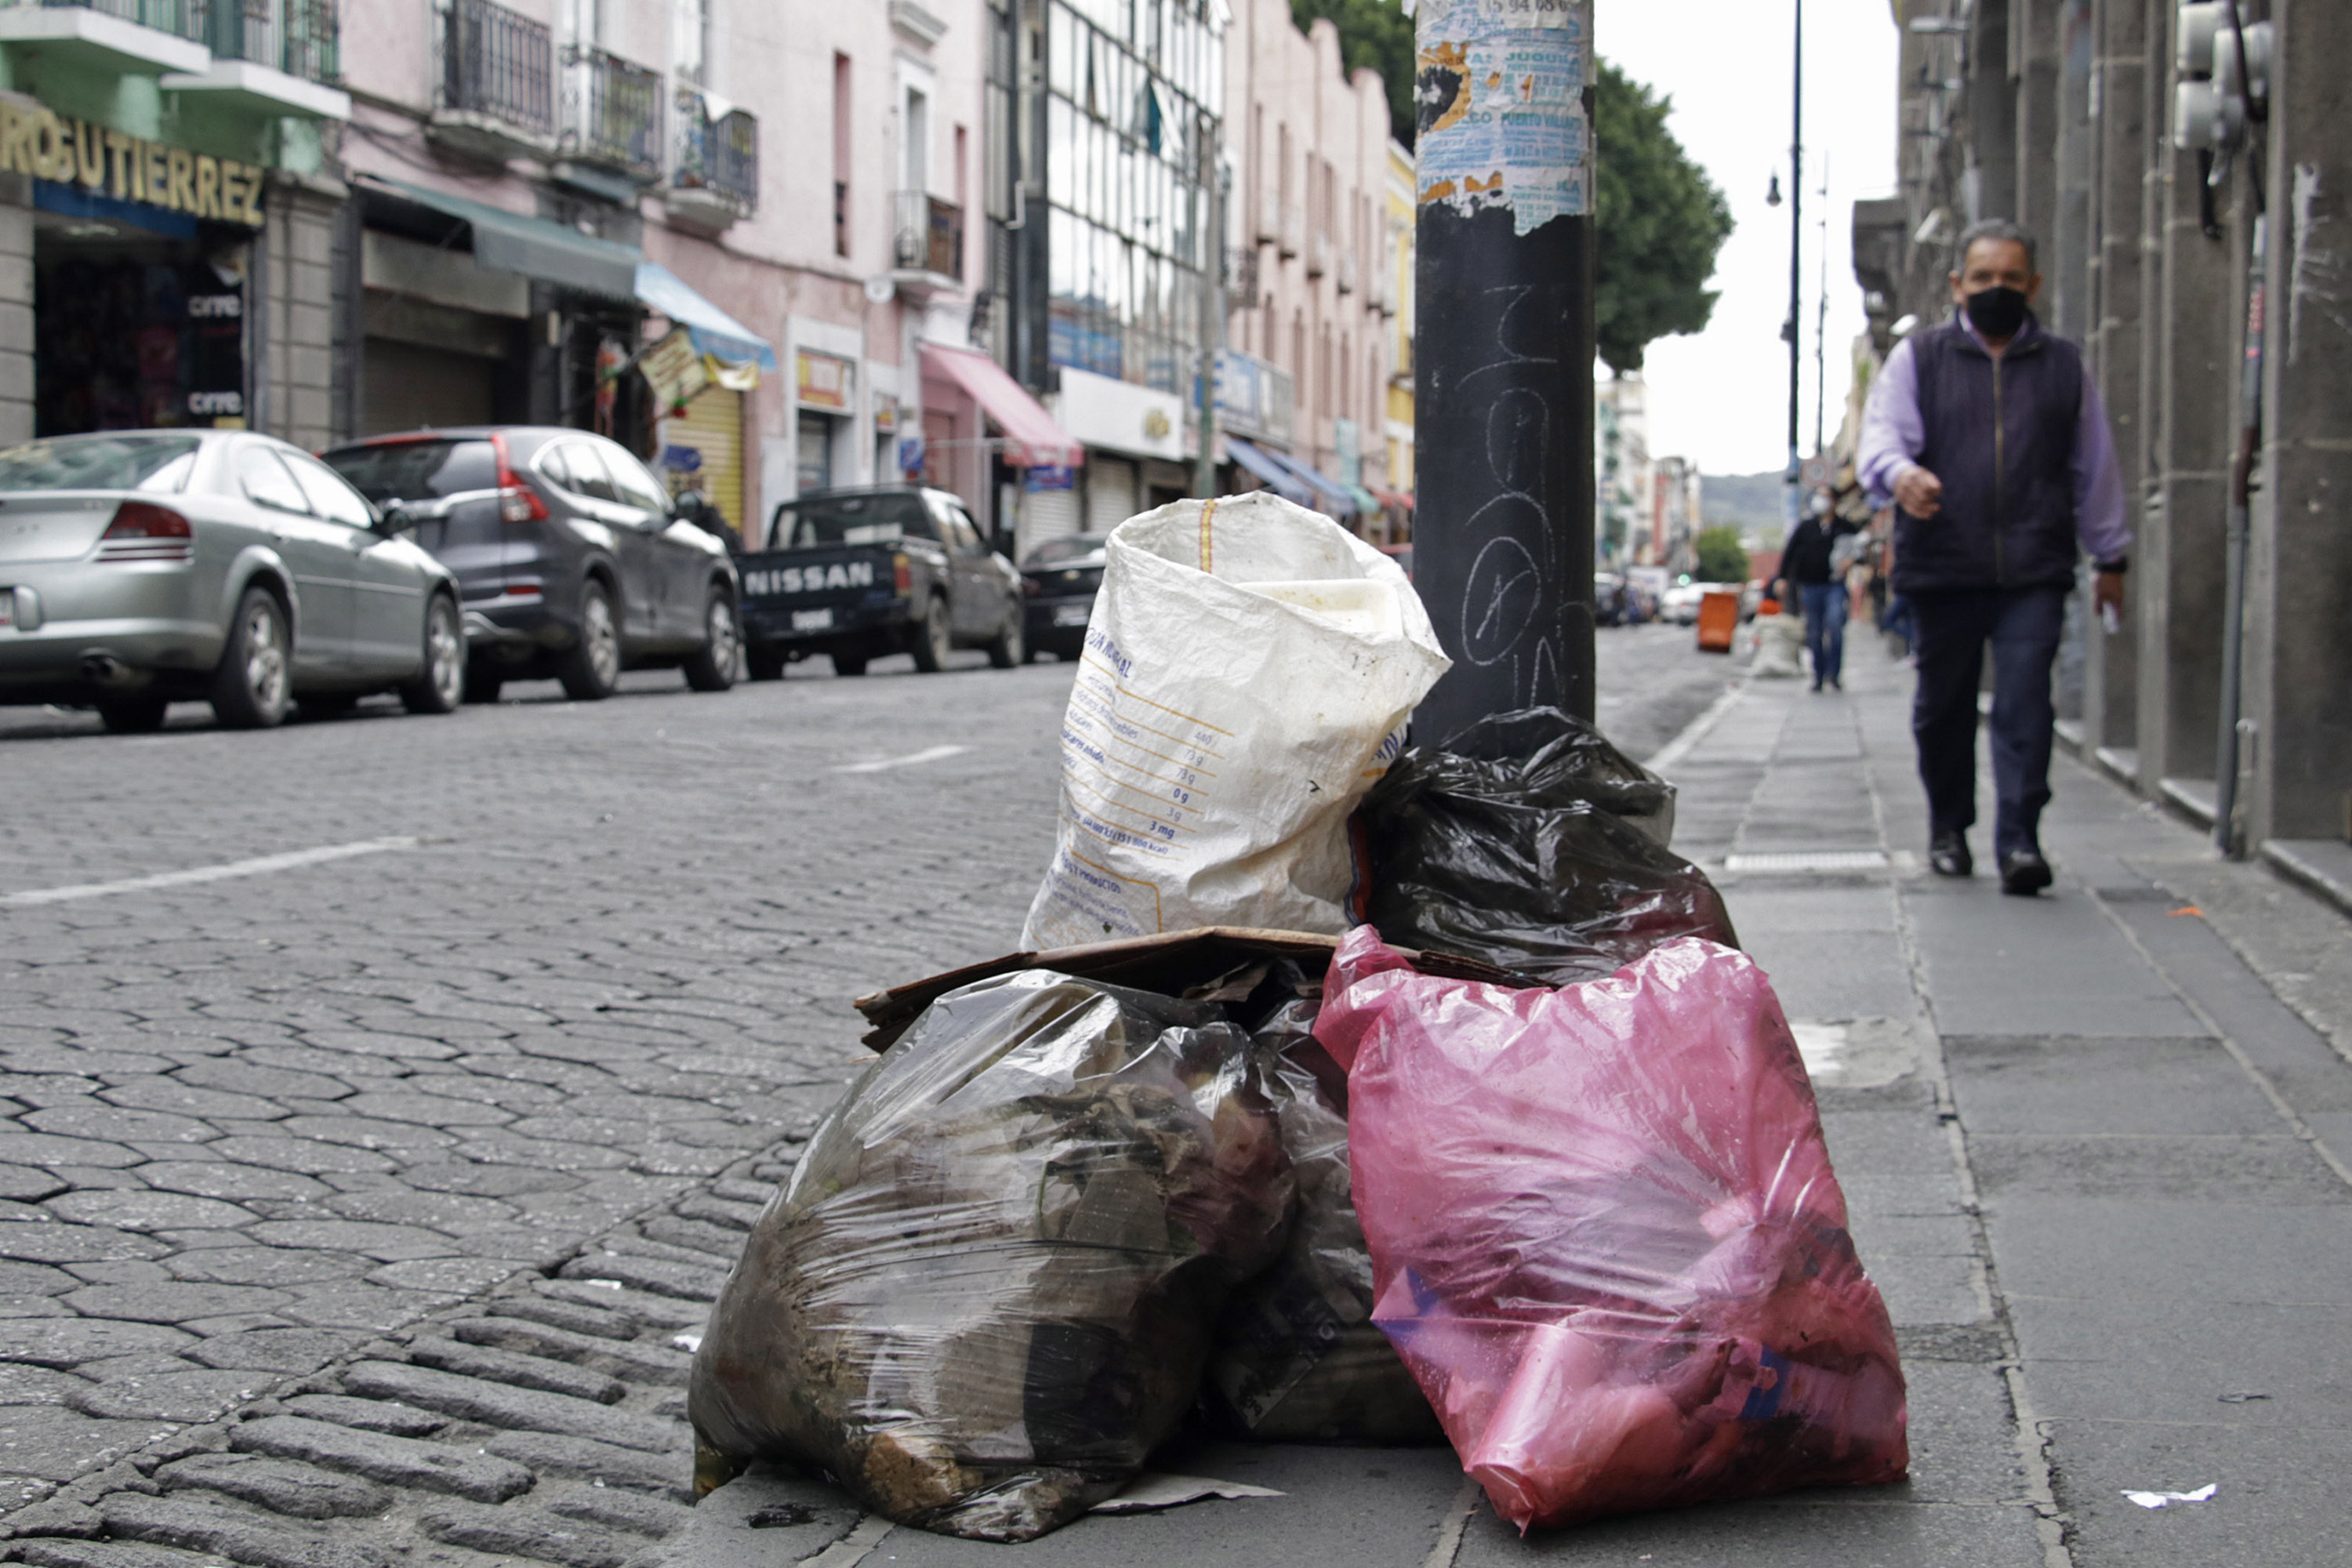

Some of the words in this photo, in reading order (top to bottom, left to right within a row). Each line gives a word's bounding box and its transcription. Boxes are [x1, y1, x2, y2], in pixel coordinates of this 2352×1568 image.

[745, 561, 873, 597] NISSAN
[1196, 756, 1204, 768] g
[1181, 793, 1189, 804] g
[1167, 806, 1175, 818] 3
[1174, 811, 1182, 822] g
[1149, 820, 1158, 831] 3
[1157, 825, 1175, 840] mg
